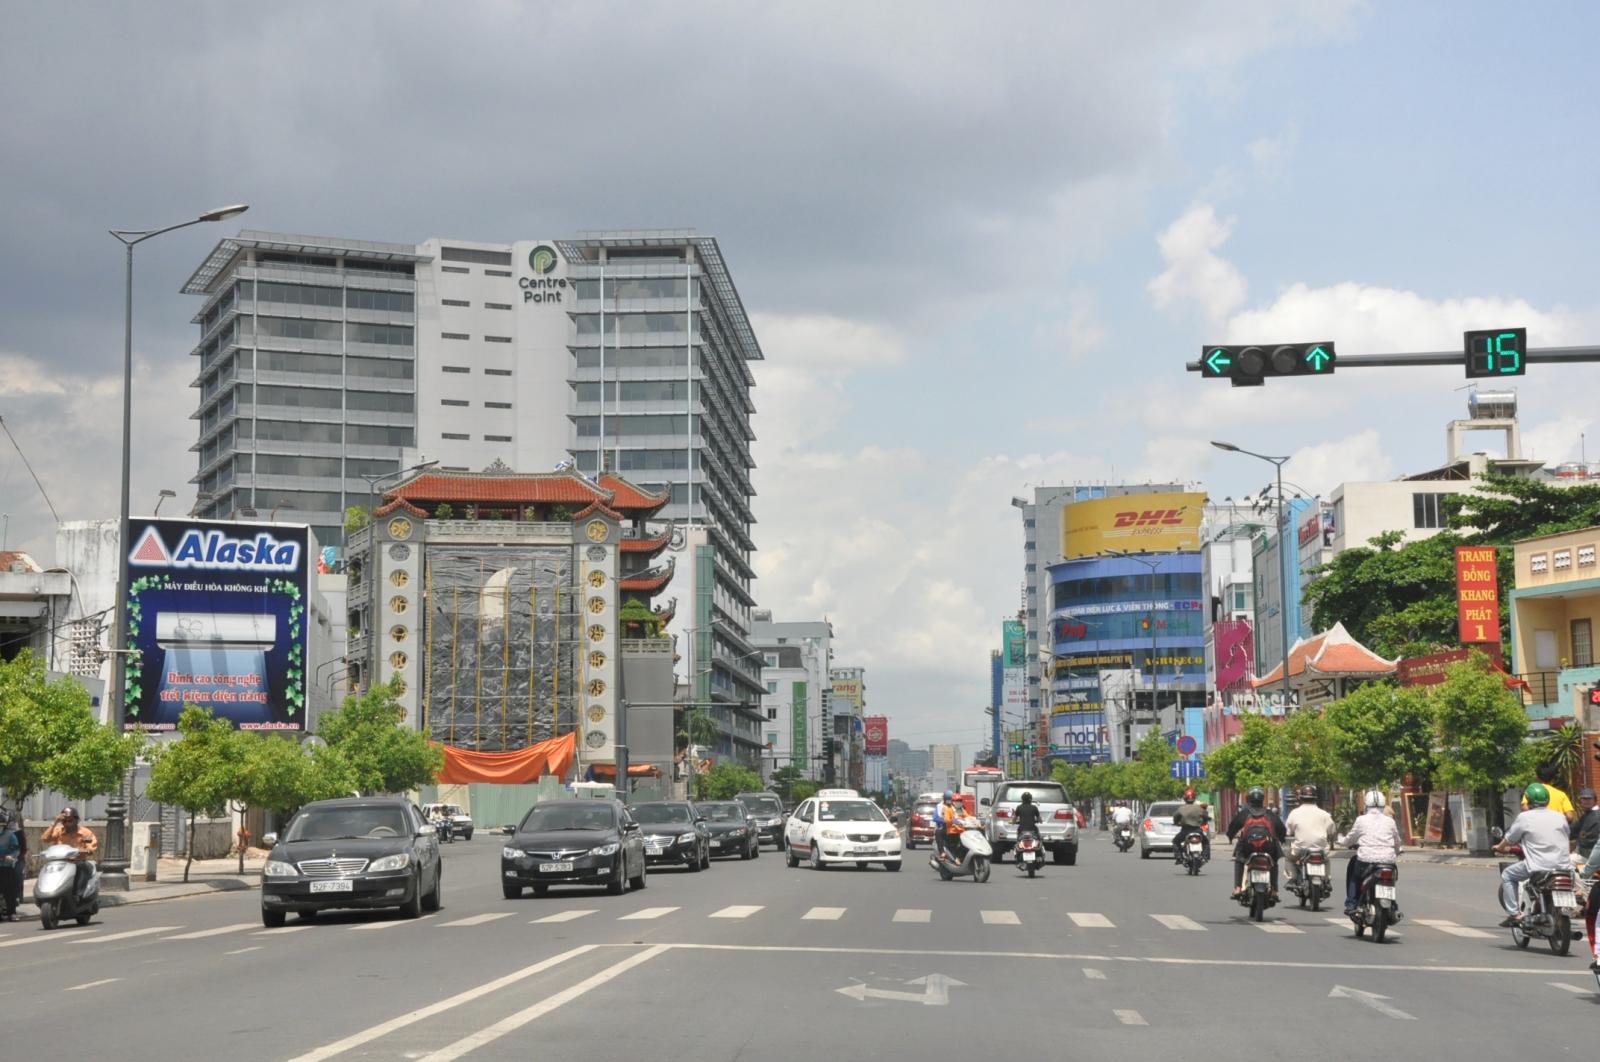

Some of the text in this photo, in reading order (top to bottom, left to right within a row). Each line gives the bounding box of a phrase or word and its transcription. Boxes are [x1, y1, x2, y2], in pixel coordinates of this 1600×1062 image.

[519, 277, 567, 289] Centre
[524, 290, 562, 303] Point
[1487, 333, 1520, 373] 15
[1114, 509, 1183, 528] DHL
[1131, 527, 1162, 536] EXPRESS
[175, 533, 295, 565] Alaska
[1459, 550, 1493, 562] TRANH
[1463, 564, 1491, 581] ĐỒNG
[224, 582, 252, 593] KHÔNG
[1460, 589, 1496, 601] KHANG
[1465, 606, 1493, 620] PHÁT
[1475, 624, 1487, 640] 1
